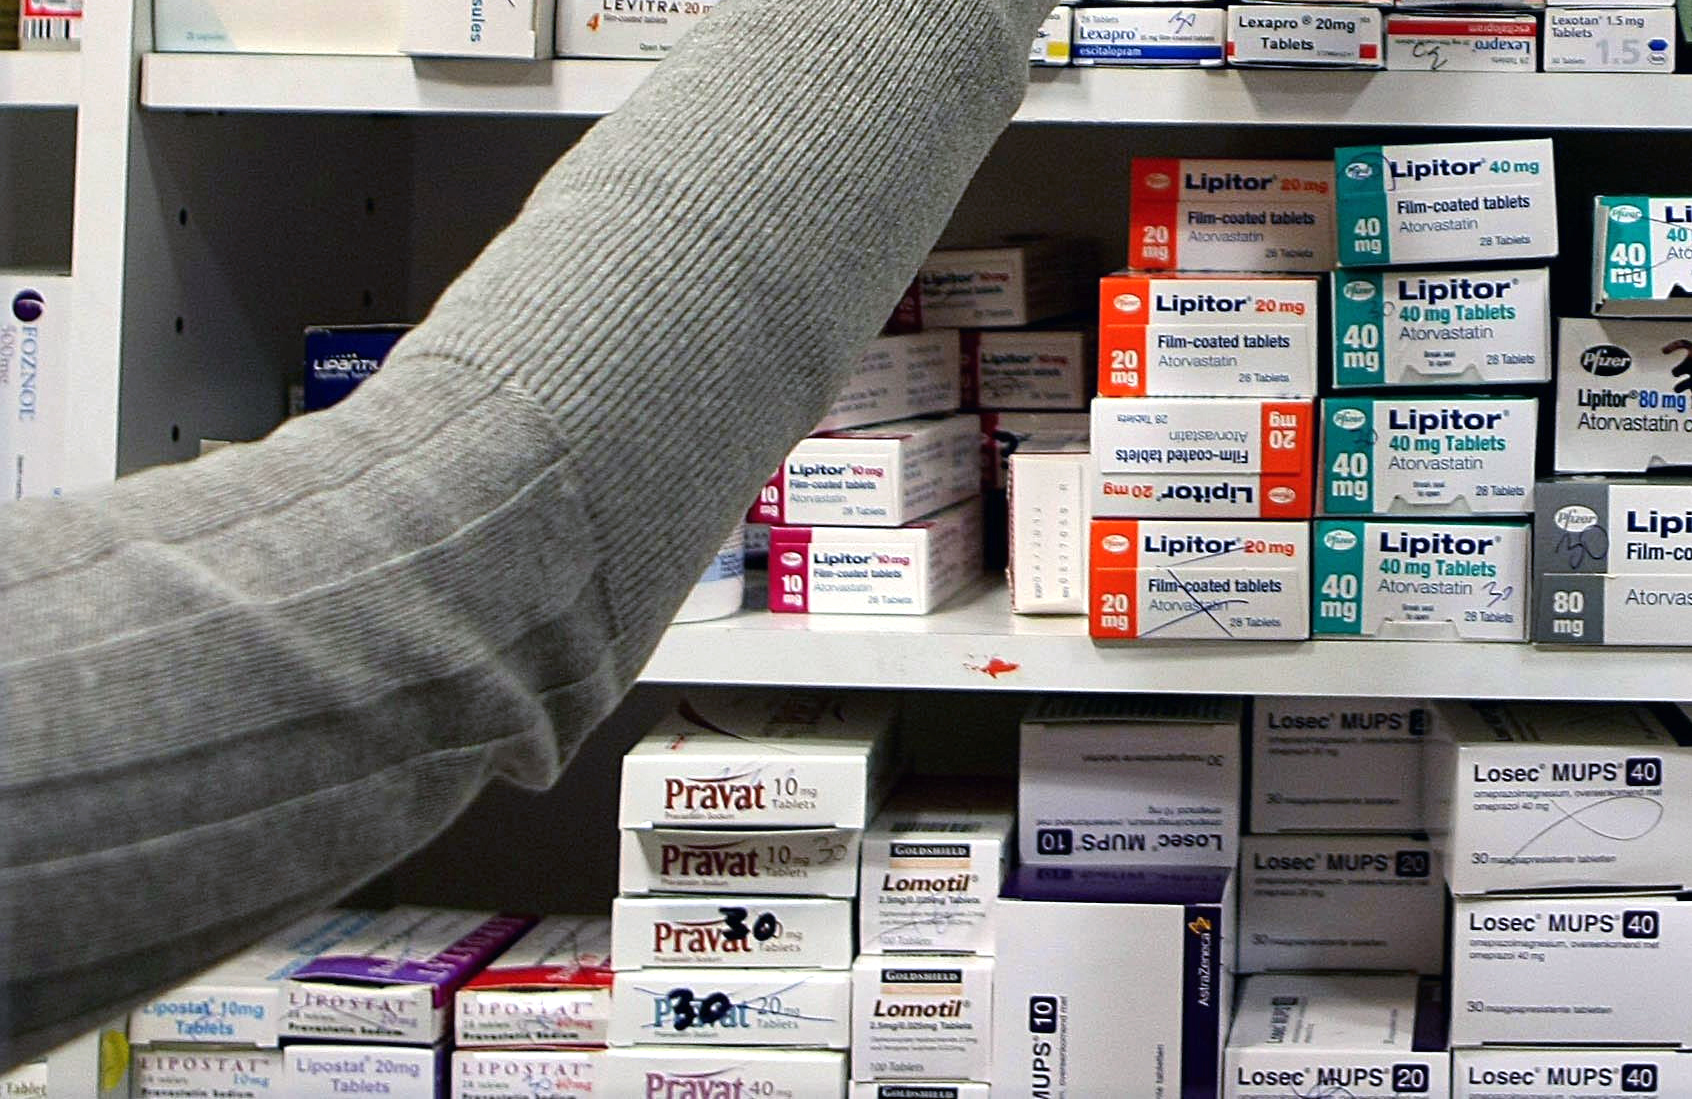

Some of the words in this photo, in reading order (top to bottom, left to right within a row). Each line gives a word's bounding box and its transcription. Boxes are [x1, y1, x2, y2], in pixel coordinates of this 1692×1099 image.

[1239, 17, 1297, 31] Lexapro
[1316, 17, 1355, 31] 20mg
[1080, 27, 1135, 41] Lexapro
[1080, 45, 1142, 57] escitalopram
[1262, 37, 1313, 51] Tablets
[1581, 348, 1630, 370] Pfizer
[1389, 410, 1500, 431] Lipitor
[1578, 414, 1679, 432] Atorvastatin
[1390, 436, 1412, 450] 40
[1416, 438, 1443, 454] mg
[1447, 436, 1506, 451] Tablets
[1388, 456, 1483, 470] Atorvastatin
[665, 777, 765, 810] Pravat
[773, 777, 797, 795] 10
[882, 873, 971, 891] Lomotil
[1470, 913, 1535, 933] Losec
[1549, 914, 1614, 932] MUPS
[1628, 915, 1654, 934] 40
[1199, 932, 1212, 1007] AstraZeneca
[297, 1060, 365, 1076] Lipostat
[370, 1061, 421, 1078] 20mg
[1238, 1067, 1304, 1086] Losec
[1317, 1068, 1382, 1086] MUPS
[1398, 1069, 1424, 1088] 20
[333, 1078, 390, 1094] Tablets
